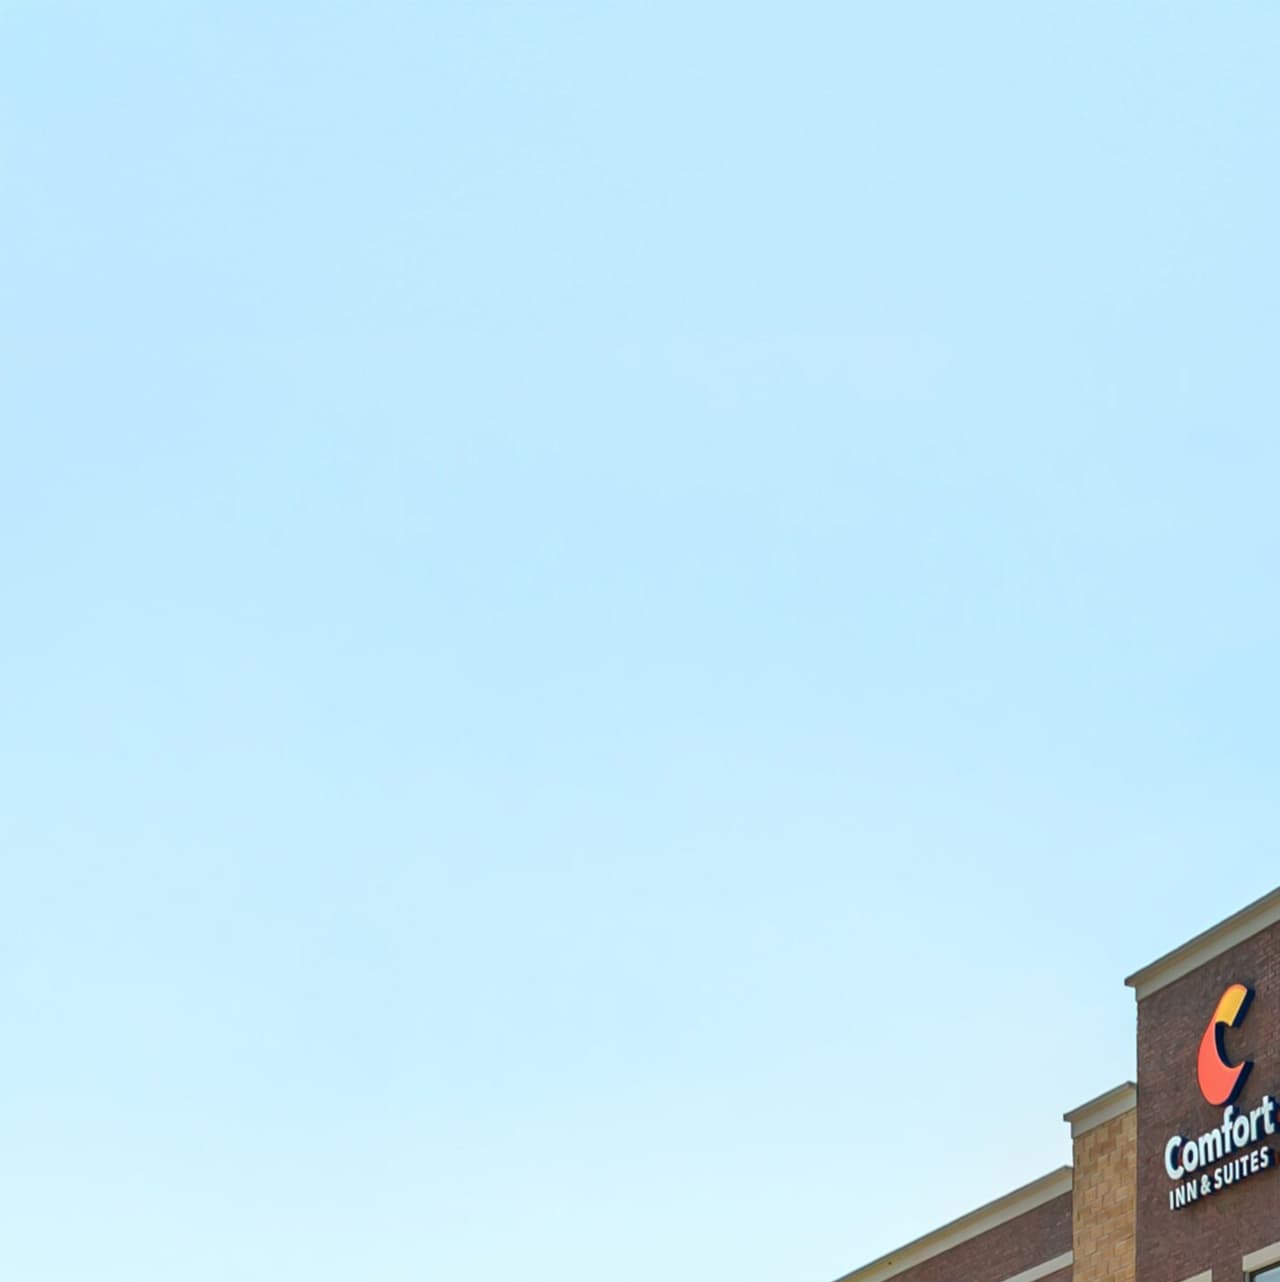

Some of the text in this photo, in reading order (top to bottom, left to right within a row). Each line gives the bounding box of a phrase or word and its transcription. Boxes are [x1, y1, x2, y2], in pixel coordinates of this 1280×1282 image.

[1165, 1095, 1275, 1180] Comfort
[1169, 1146, 1270, 1211] INN & SUITES
